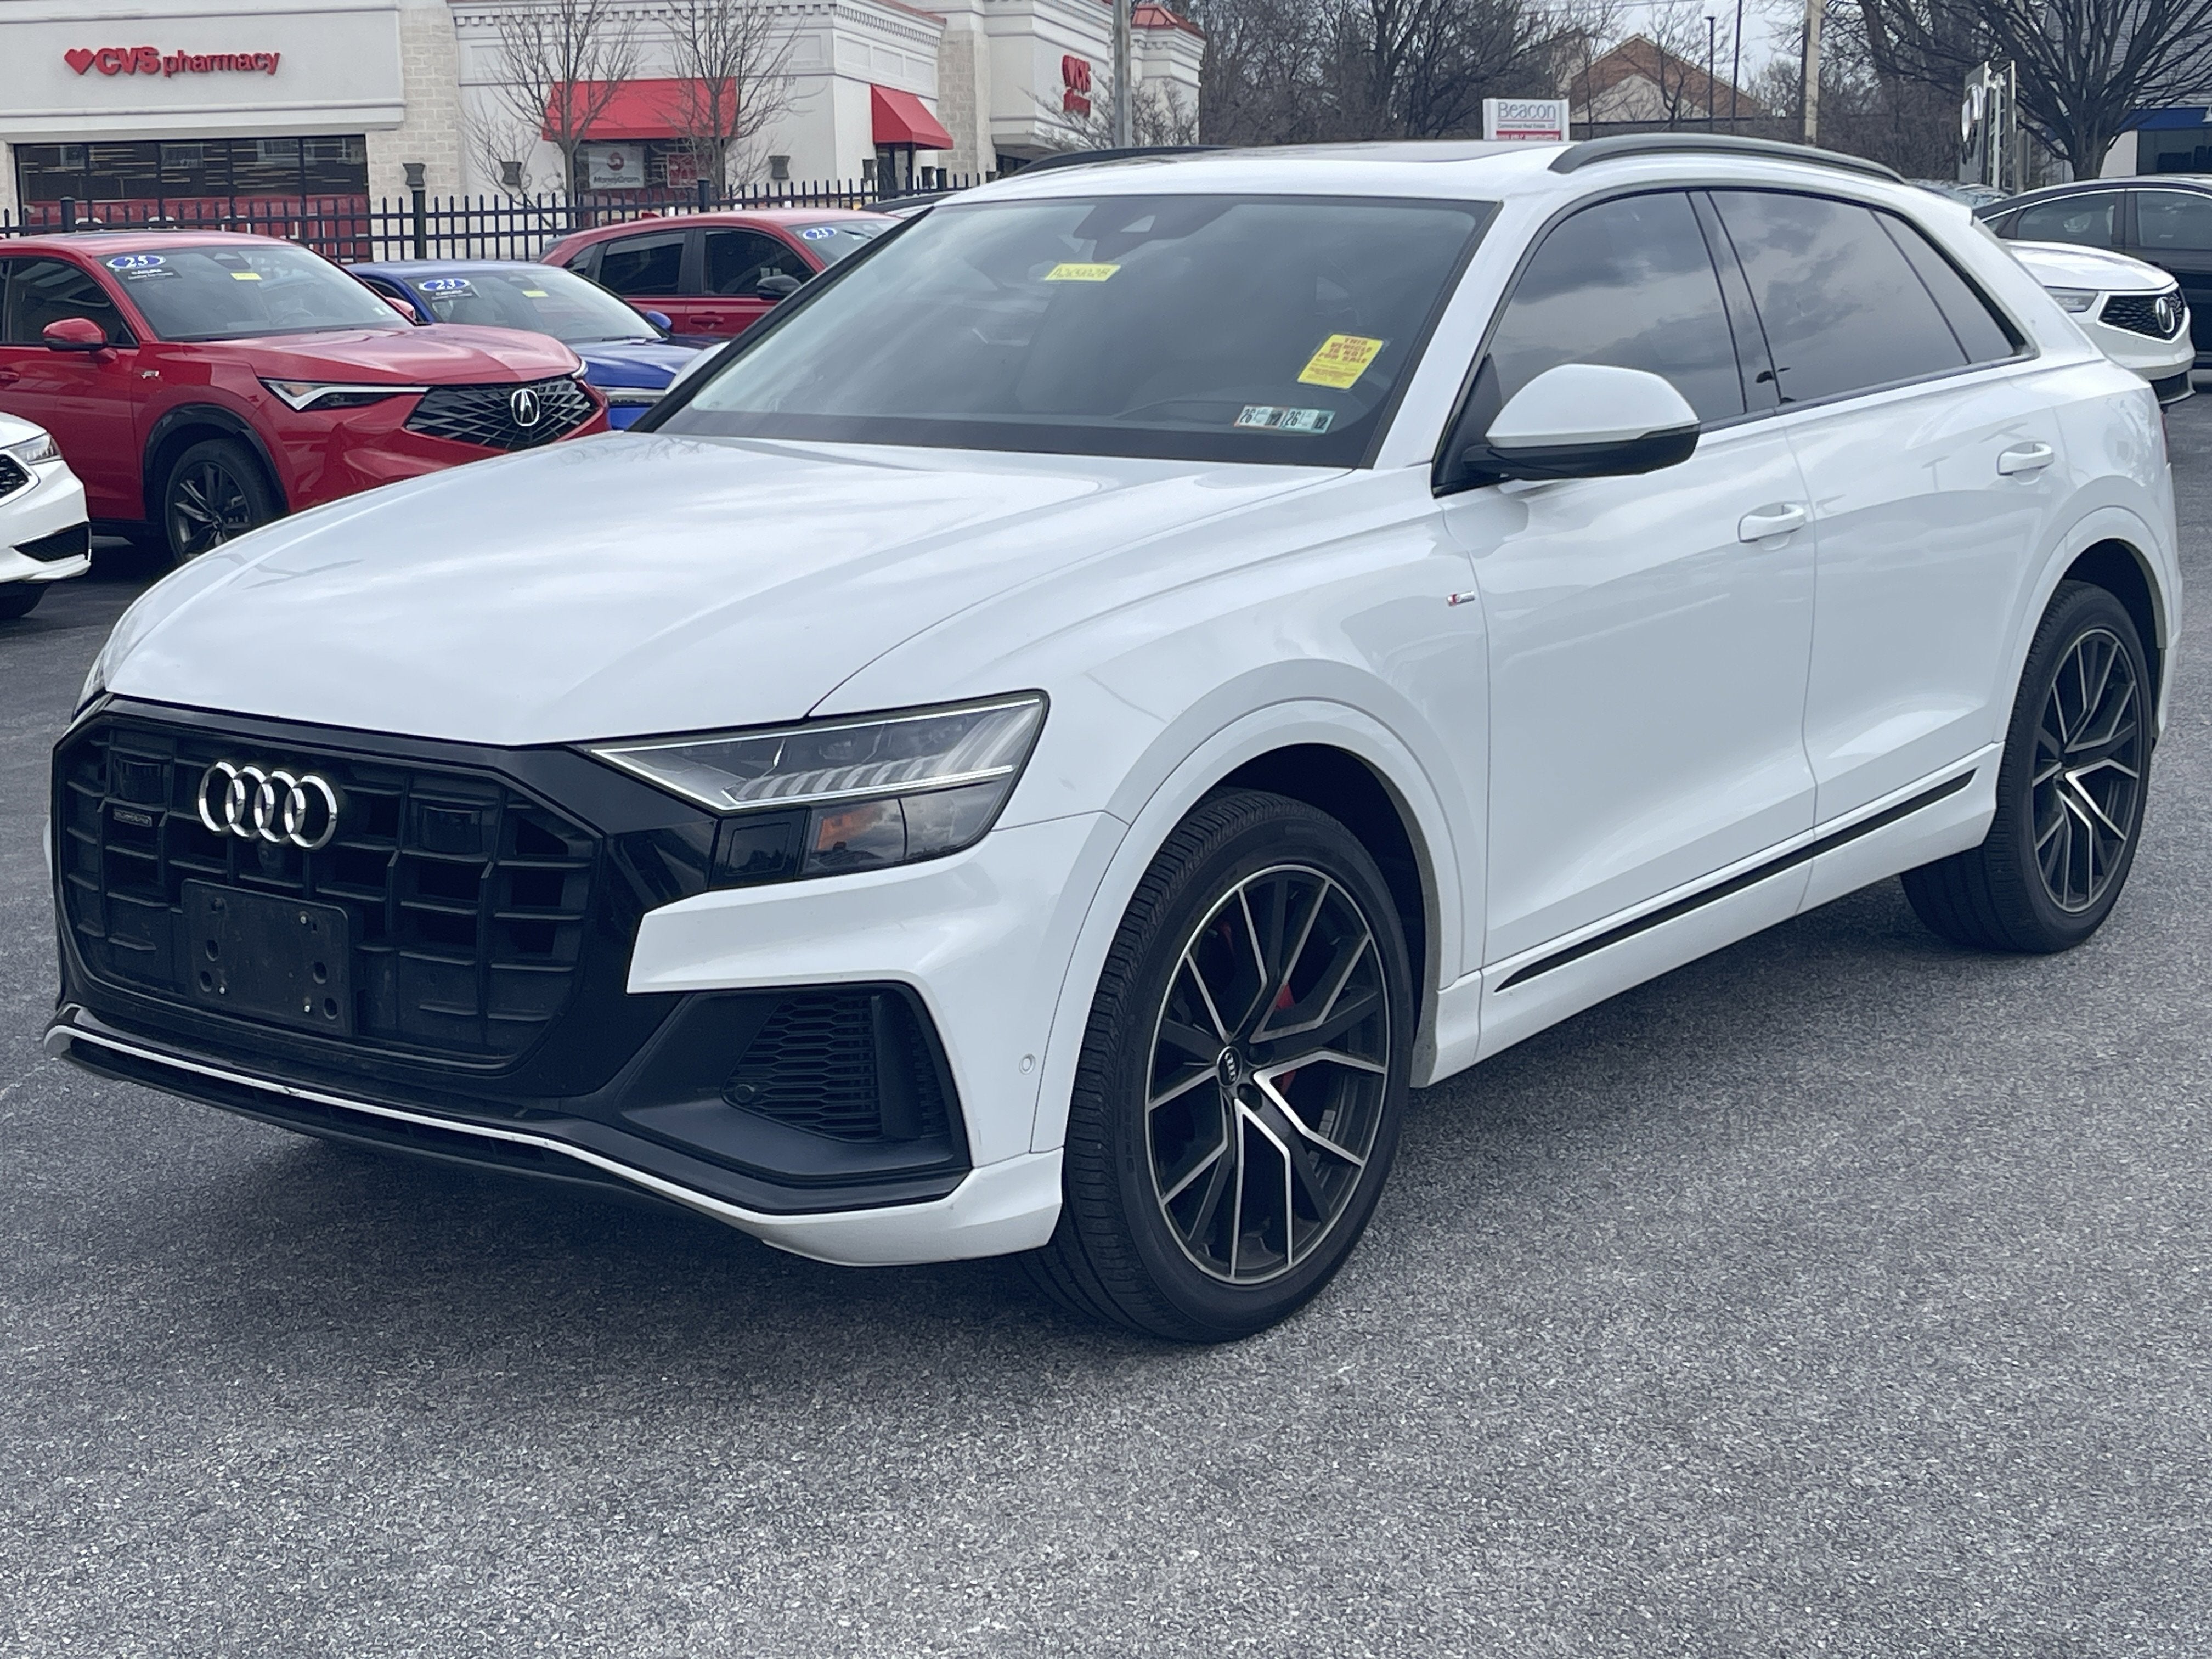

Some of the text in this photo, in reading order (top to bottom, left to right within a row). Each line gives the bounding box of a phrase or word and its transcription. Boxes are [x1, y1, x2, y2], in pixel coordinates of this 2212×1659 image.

[94, 47, 280, 78] CVS pharmacy
[1498, 102, 1556, 119] Beacon
[594, 176, 640, 184] MoneyGram
[124, 255, 148, 267] 25
[436, 279, 456, 290] 23
[1239, 409, 1256, 423] 26
[1285, 411, 1301, 426] 26
